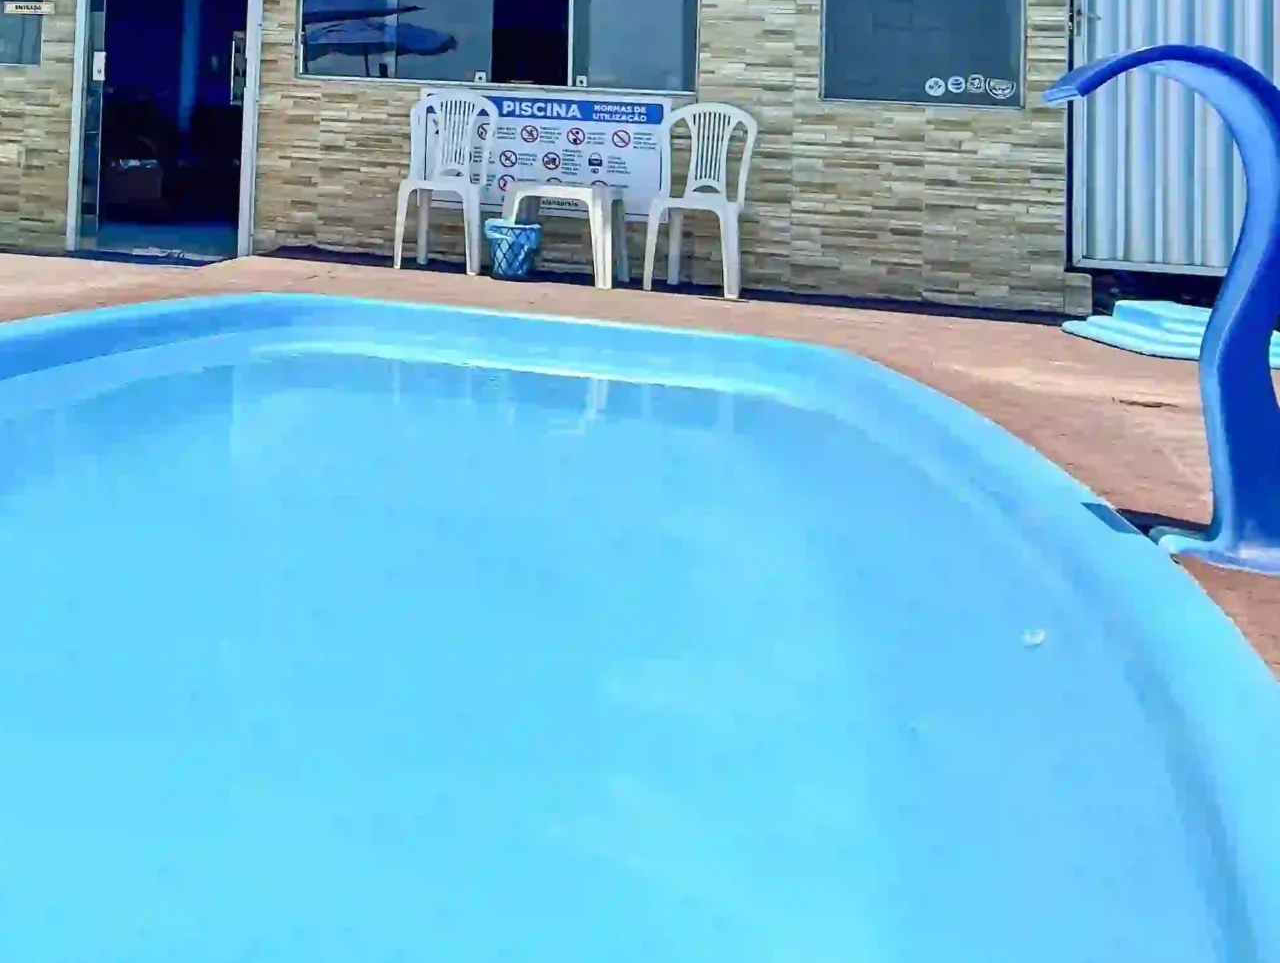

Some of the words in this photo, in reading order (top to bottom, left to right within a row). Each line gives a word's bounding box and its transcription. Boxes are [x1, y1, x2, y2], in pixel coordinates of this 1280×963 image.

[502, 100, 582, 119] PISCINA
[594, 104, 632, 113] NORMAS
[634, 106, 646, 114] DE
[592, 113, 647, 122] UTILIZAÇÃO
